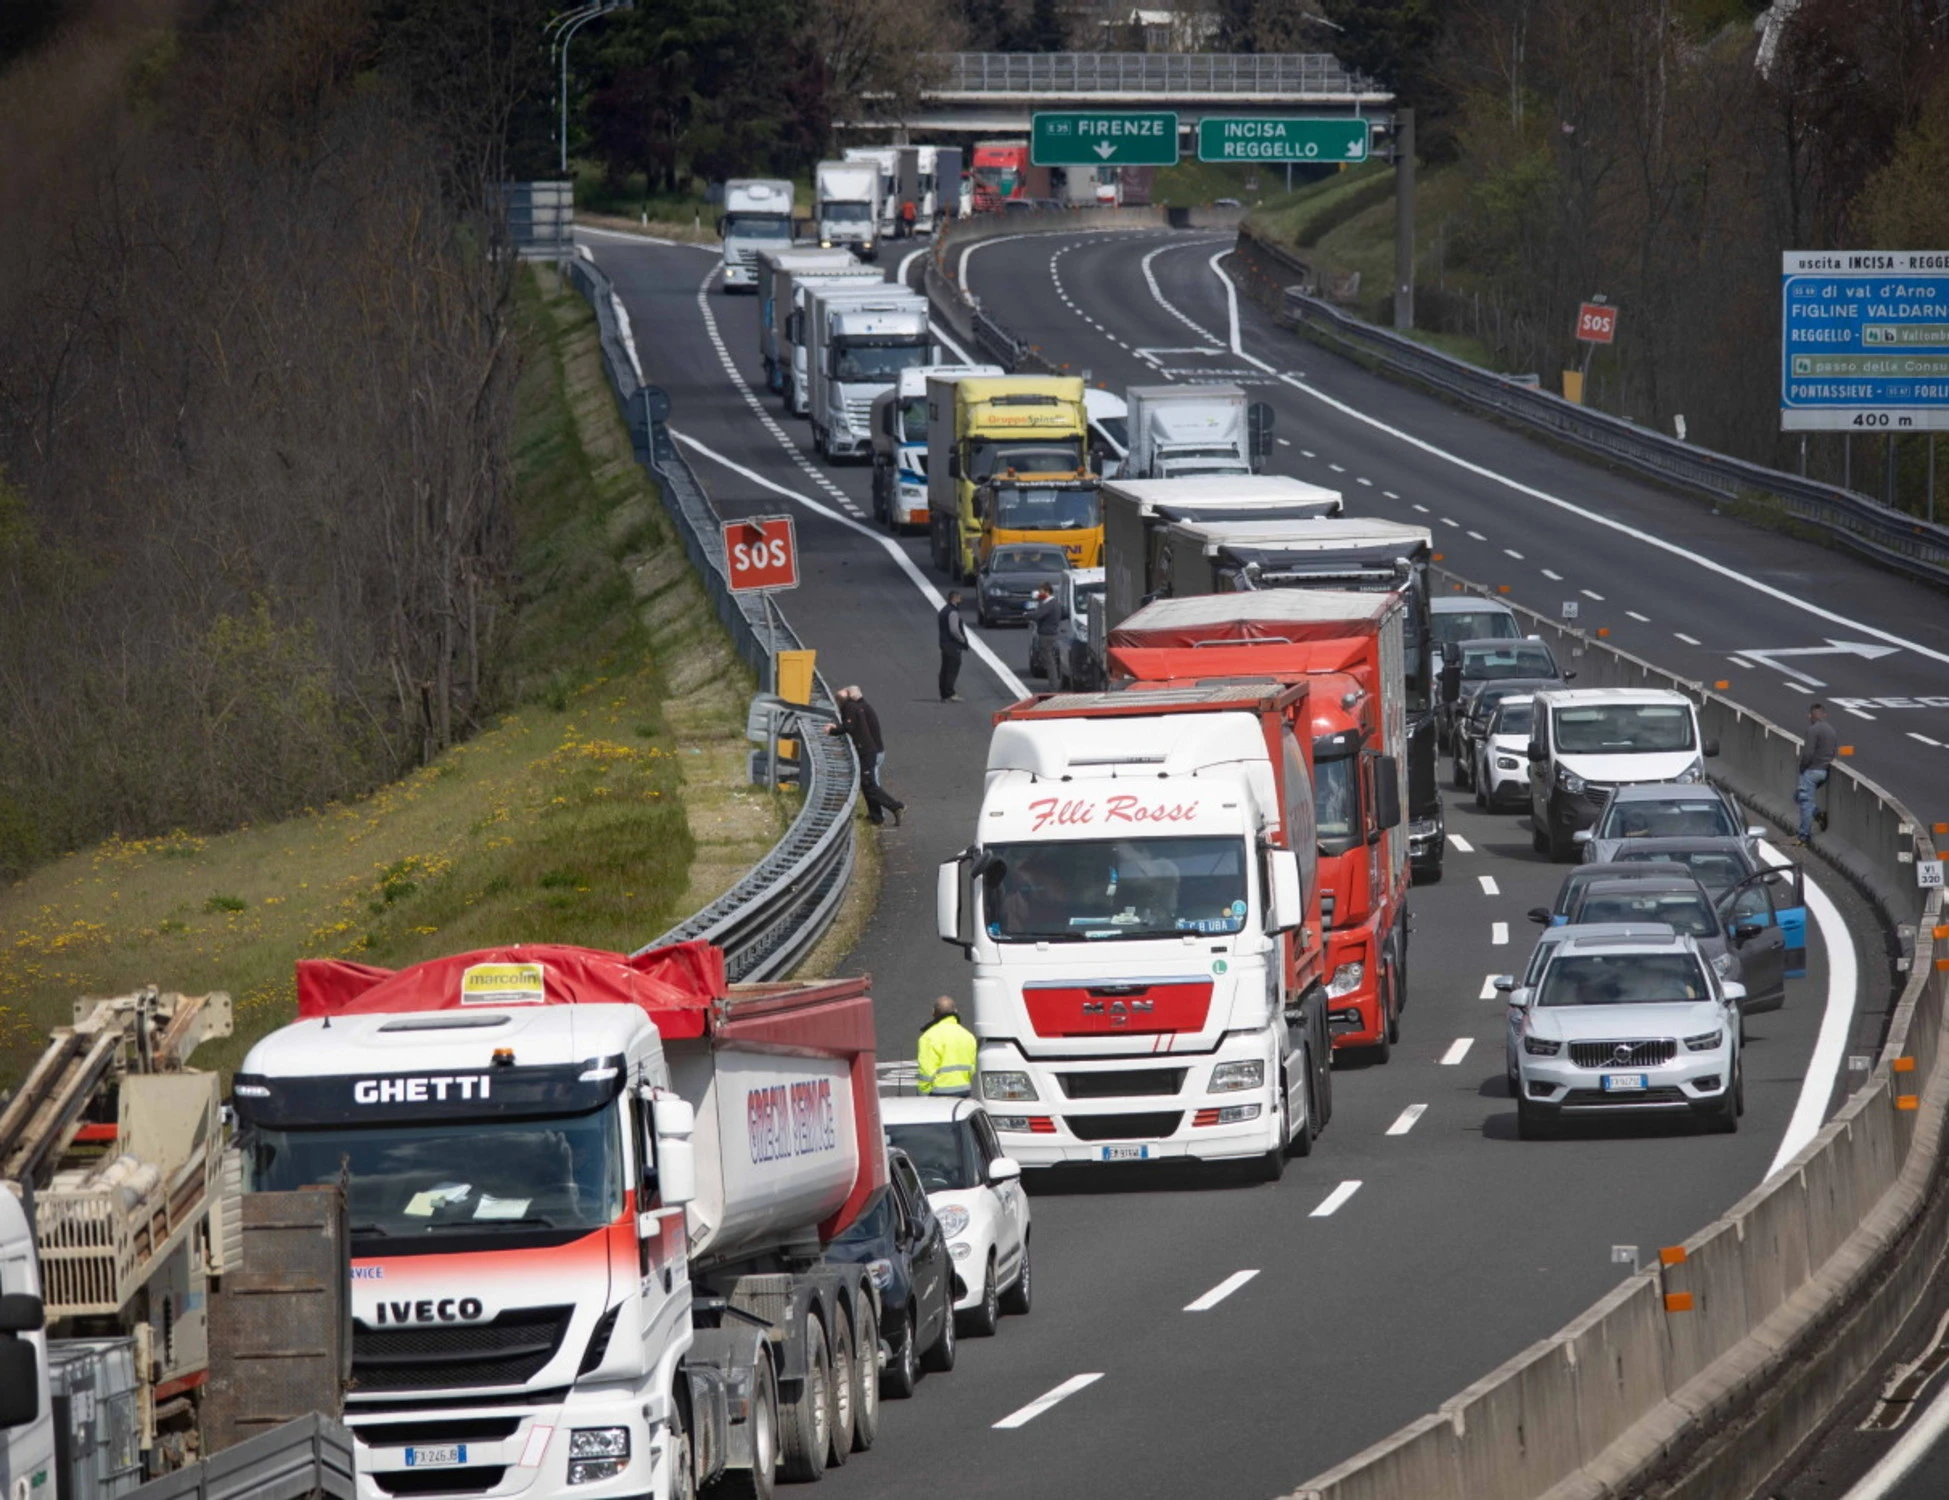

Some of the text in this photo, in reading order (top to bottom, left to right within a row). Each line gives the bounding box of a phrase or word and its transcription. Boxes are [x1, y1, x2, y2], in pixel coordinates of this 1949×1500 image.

[1078, 120, 1165, 136] FIRENZE
[1224, 122, 1287, 137] INCISA
[1224, 142, 1318, 157] REGGELLO
[1799, 256, 1841, 269] uscita
[1849, 256, 1894, 269] INCISA
[1909, 256, 1949, 269] REGGE
[1822, 284, 1837, 297] di
[1846, 284, 1872, 297] val
[1880, 284, 1936, 297] d'Arno
[1792, 304, 1949, 317] FIGLINE VALDARN
[1583, 314, 1611, 332] SOS
[1791, 329, 1852, 342] REGGELLO
[1816, 363, 1856, 374] passo
[1863, 361, 1898, 373] della
[1791, 385, 1873, 398] PONTASSIEVE
[1853, 413, 1912, 427] 400 m
[734, 539, 787, 571] SOS
[1105, 795, 1199, 822] Rossi
[1083, 1000, 1154, 1015] MAN
[354, 1075, 490, 1104] GHETTI
[376, 1297, 483, 1324] IVECO
